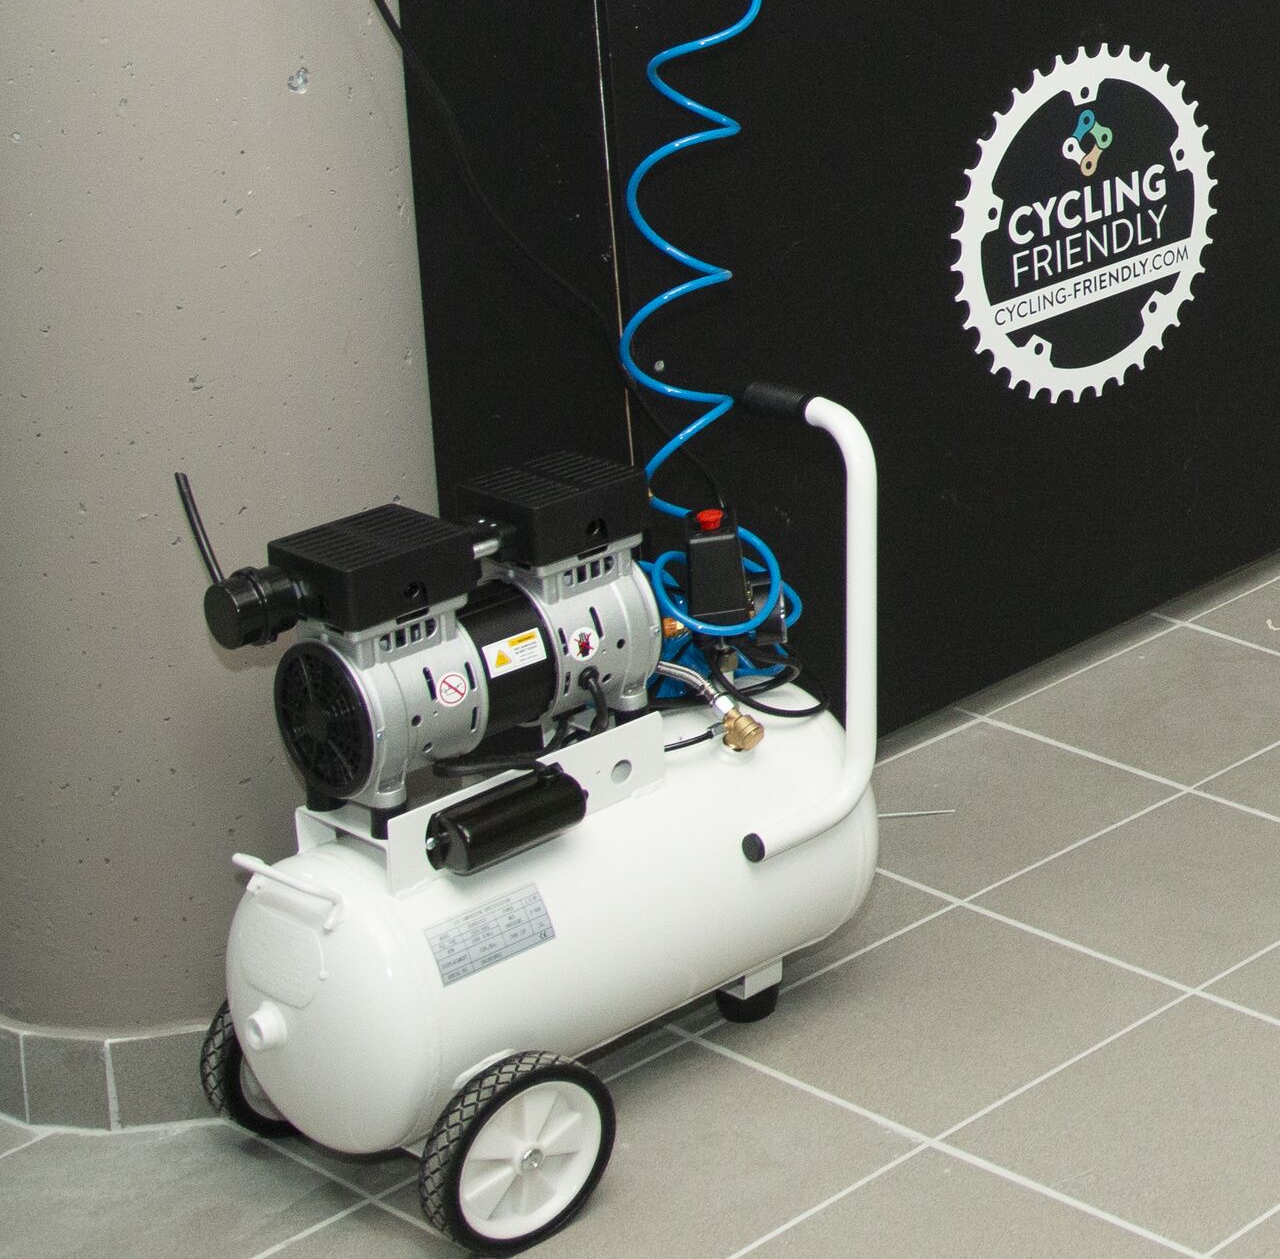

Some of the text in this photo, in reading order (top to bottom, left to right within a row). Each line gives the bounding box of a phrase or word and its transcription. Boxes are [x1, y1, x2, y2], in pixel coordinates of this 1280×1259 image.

[1008, 164, 1167, 244] CYCLING
[994, 244, 1190, 327] CYCLING-FRIENDLY.COM
[1013, 204, 1168, 288] FRIENDLY
